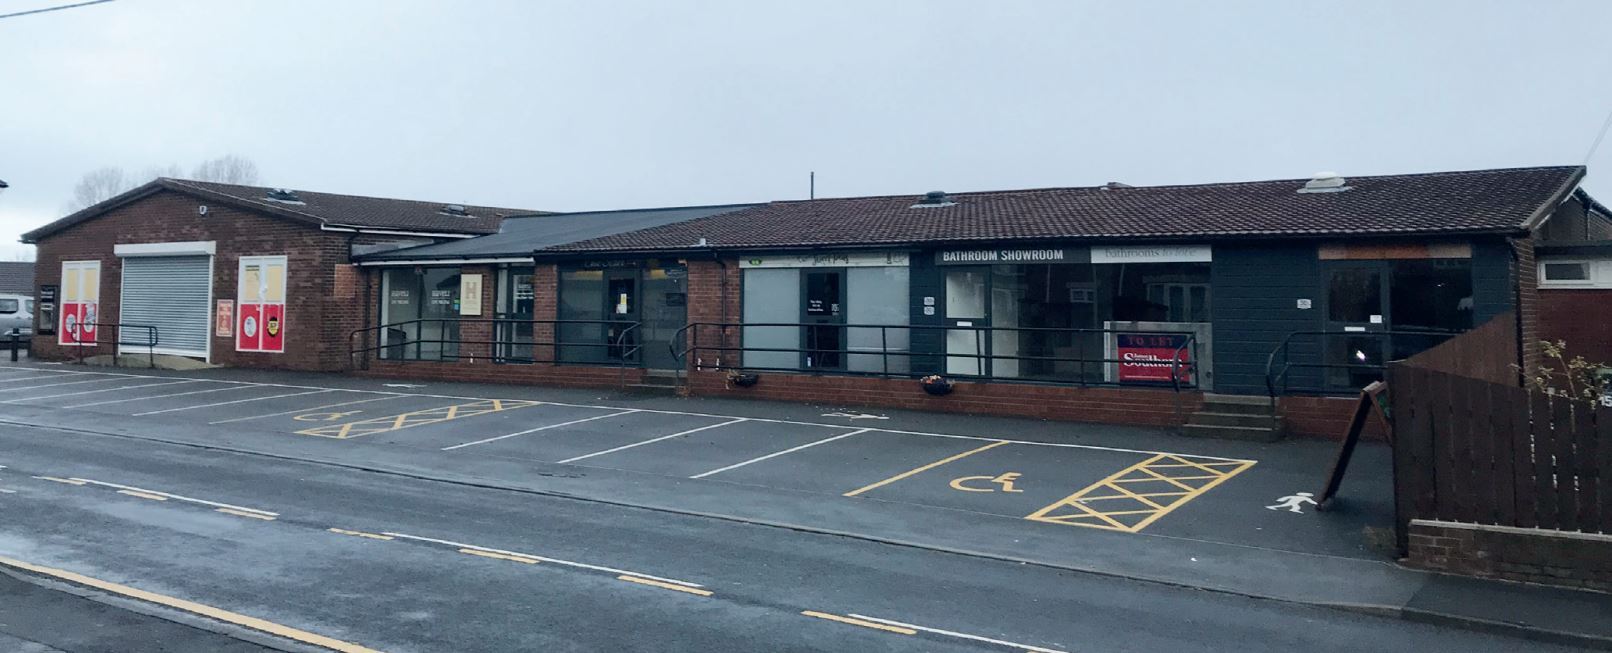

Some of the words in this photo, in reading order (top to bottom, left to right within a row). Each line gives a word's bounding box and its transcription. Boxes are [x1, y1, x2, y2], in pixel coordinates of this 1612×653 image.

[943, 250, 998, 262] BATHROOM
[1001, 249, 1064, 261] SHOWROOM
[1128, 336, 1144, 346] TO
[1151, 336, 1174, 346] LET
